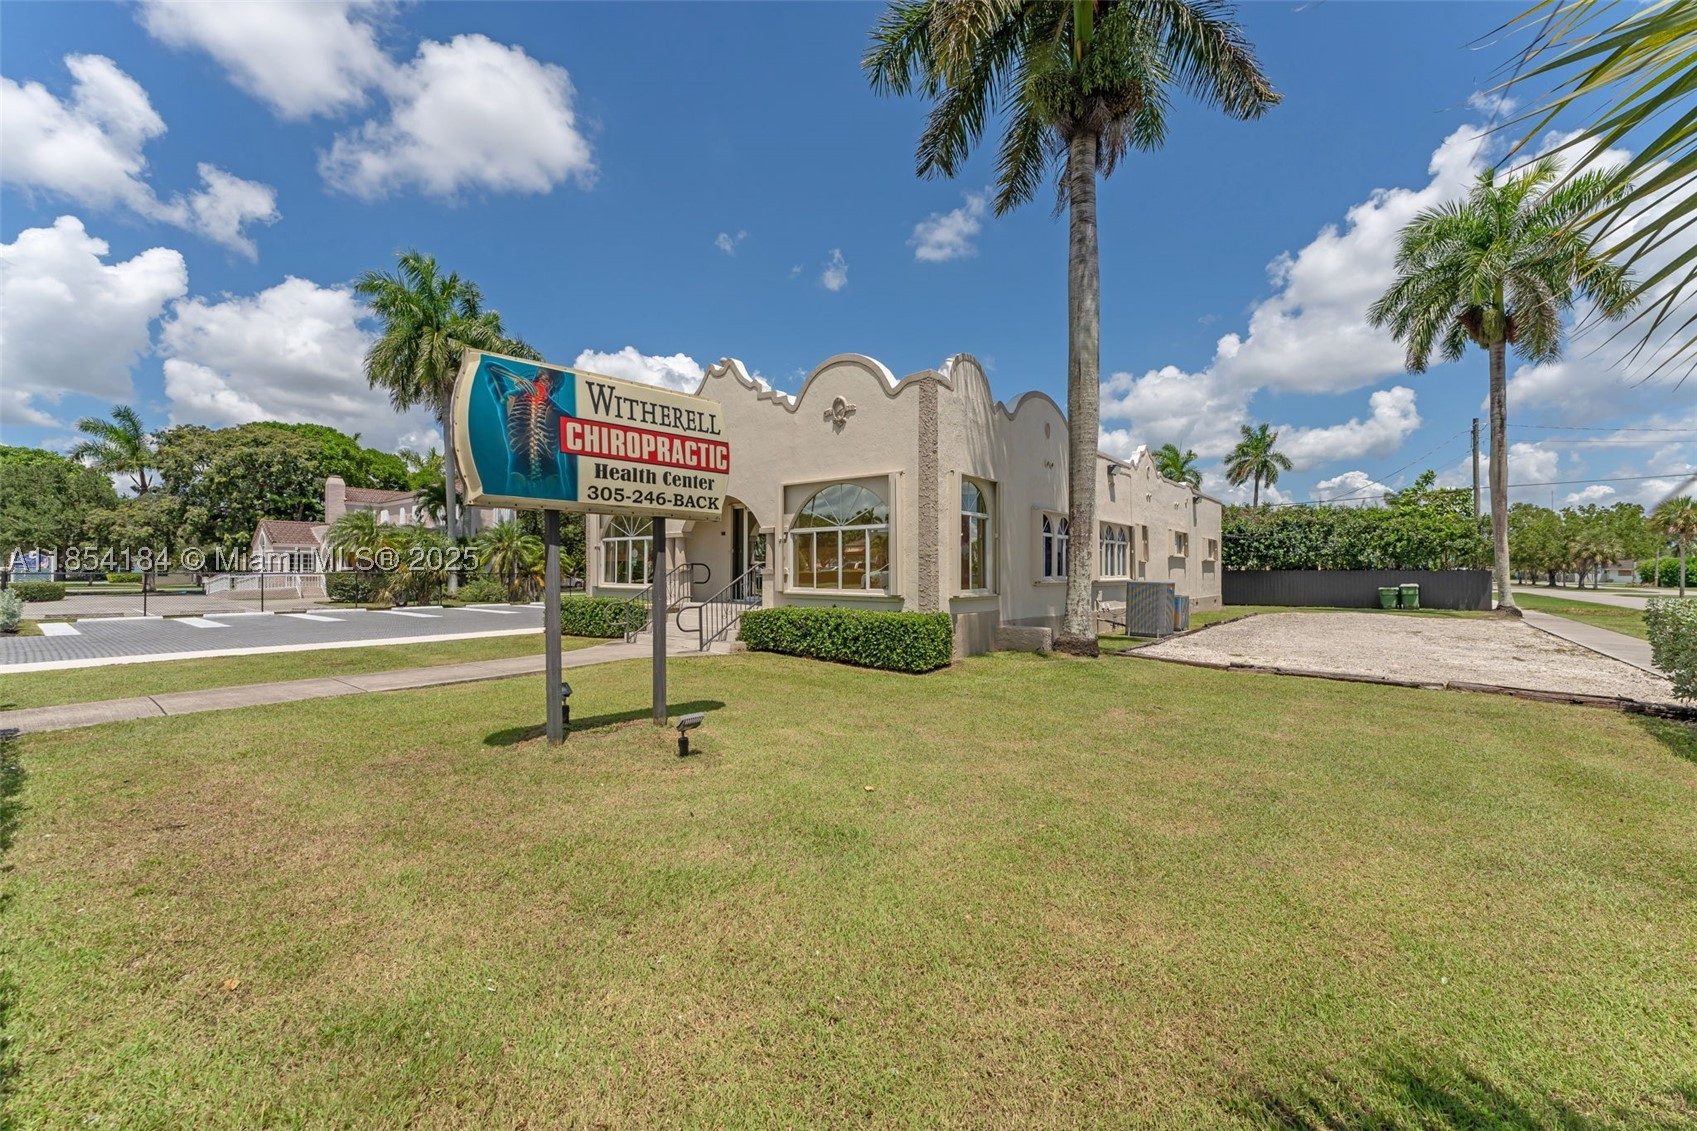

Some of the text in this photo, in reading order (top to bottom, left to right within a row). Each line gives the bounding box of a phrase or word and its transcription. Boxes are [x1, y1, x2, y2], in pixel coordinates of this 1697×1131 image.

[585, 381, 721, 436] WITHERELL
[566, 421, 728, 471] CHIROPRACTIC
[594, 463, 715, 491] Health Center
[587, 485, 720, 511] 305-246-BACK
